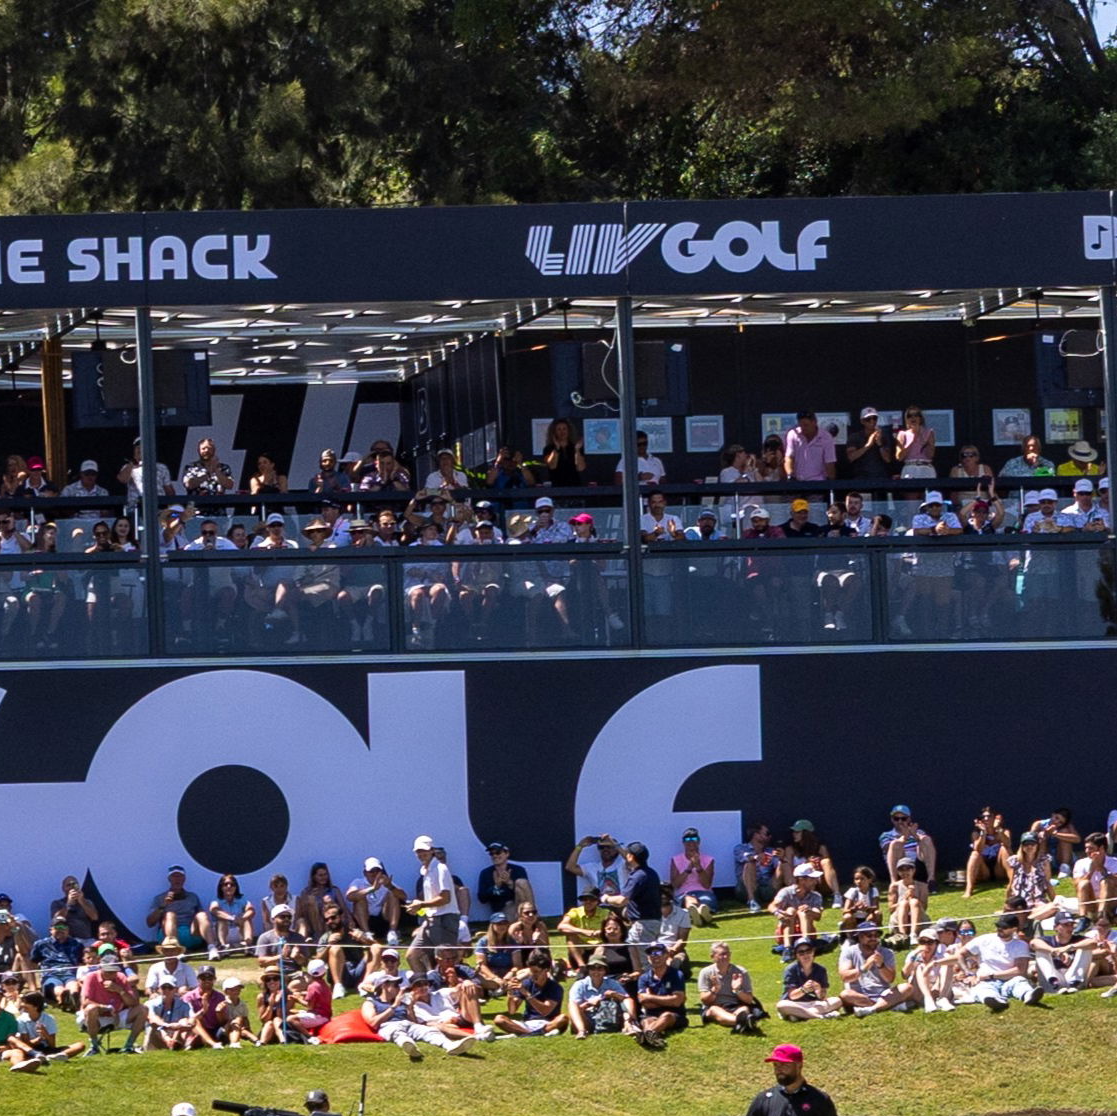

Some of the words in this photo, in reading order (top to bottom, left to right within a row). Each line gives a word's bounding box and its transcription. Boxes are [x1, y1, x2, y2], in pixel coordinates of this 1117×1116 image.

[66, 234, 278, 283] SHACK
[525, 222, 667, 276] LIV
[660, 220, 831, 274] GOLF
